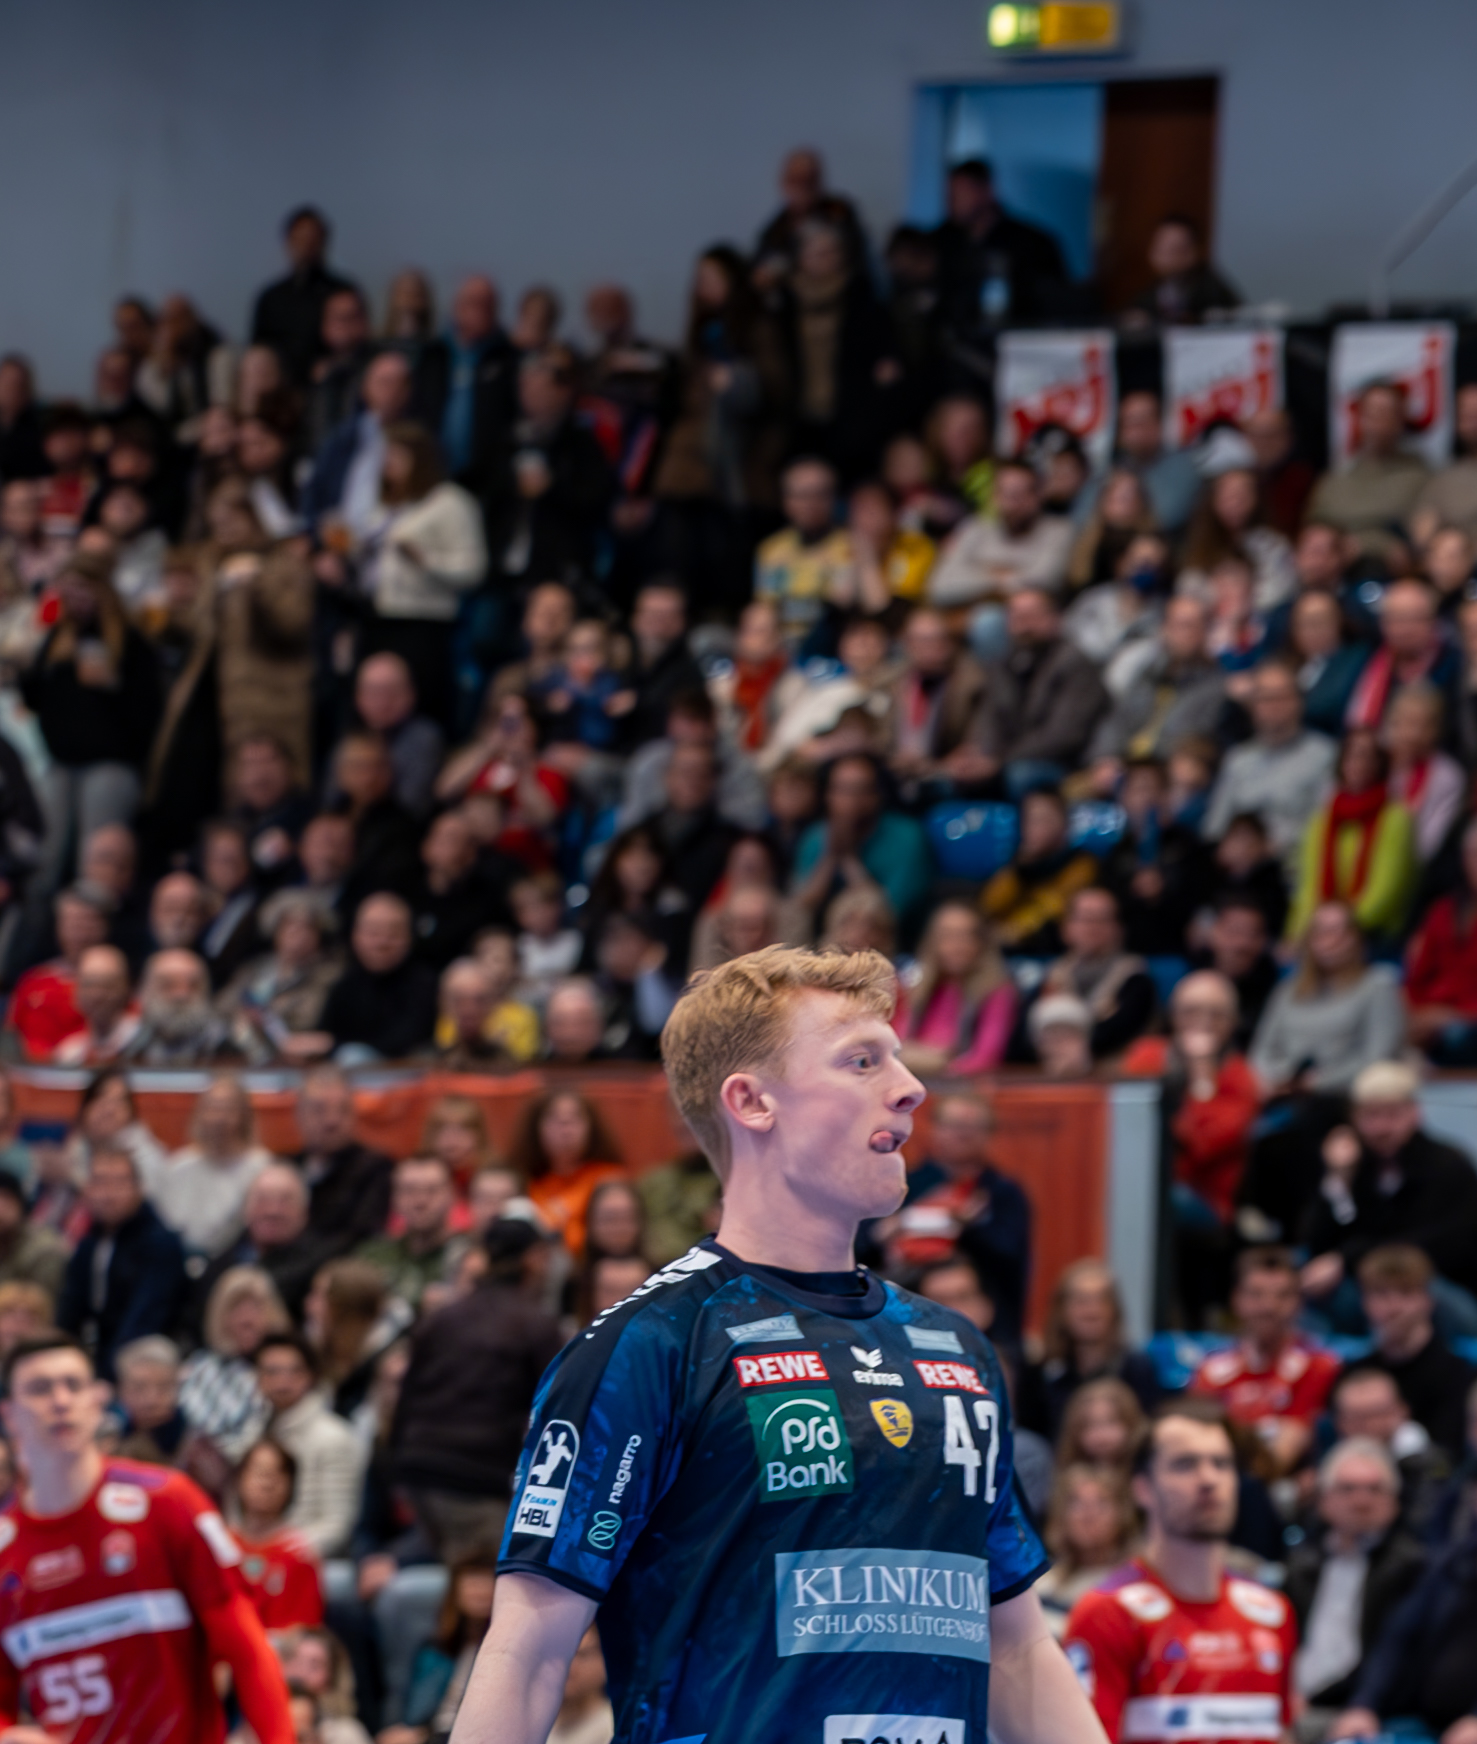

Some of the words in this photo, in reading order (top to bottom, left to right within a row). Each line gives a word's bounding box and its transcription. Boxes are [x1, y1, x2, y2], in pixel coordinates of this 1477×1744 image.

[740, 1354, 827, 1383] REWE
[852, 1368, 904, 1387] erima
[916, 1362, 983, 1391] REWE
[767, 1454, 848, 1492] Bank
[519, 1507, 552, 1528] HBL
[792, 1565, 986, 1614] KLINIKUM
[793, 1614, 898, 1637] SCHLOSS
[39, 1654, 113, 1723] 55
